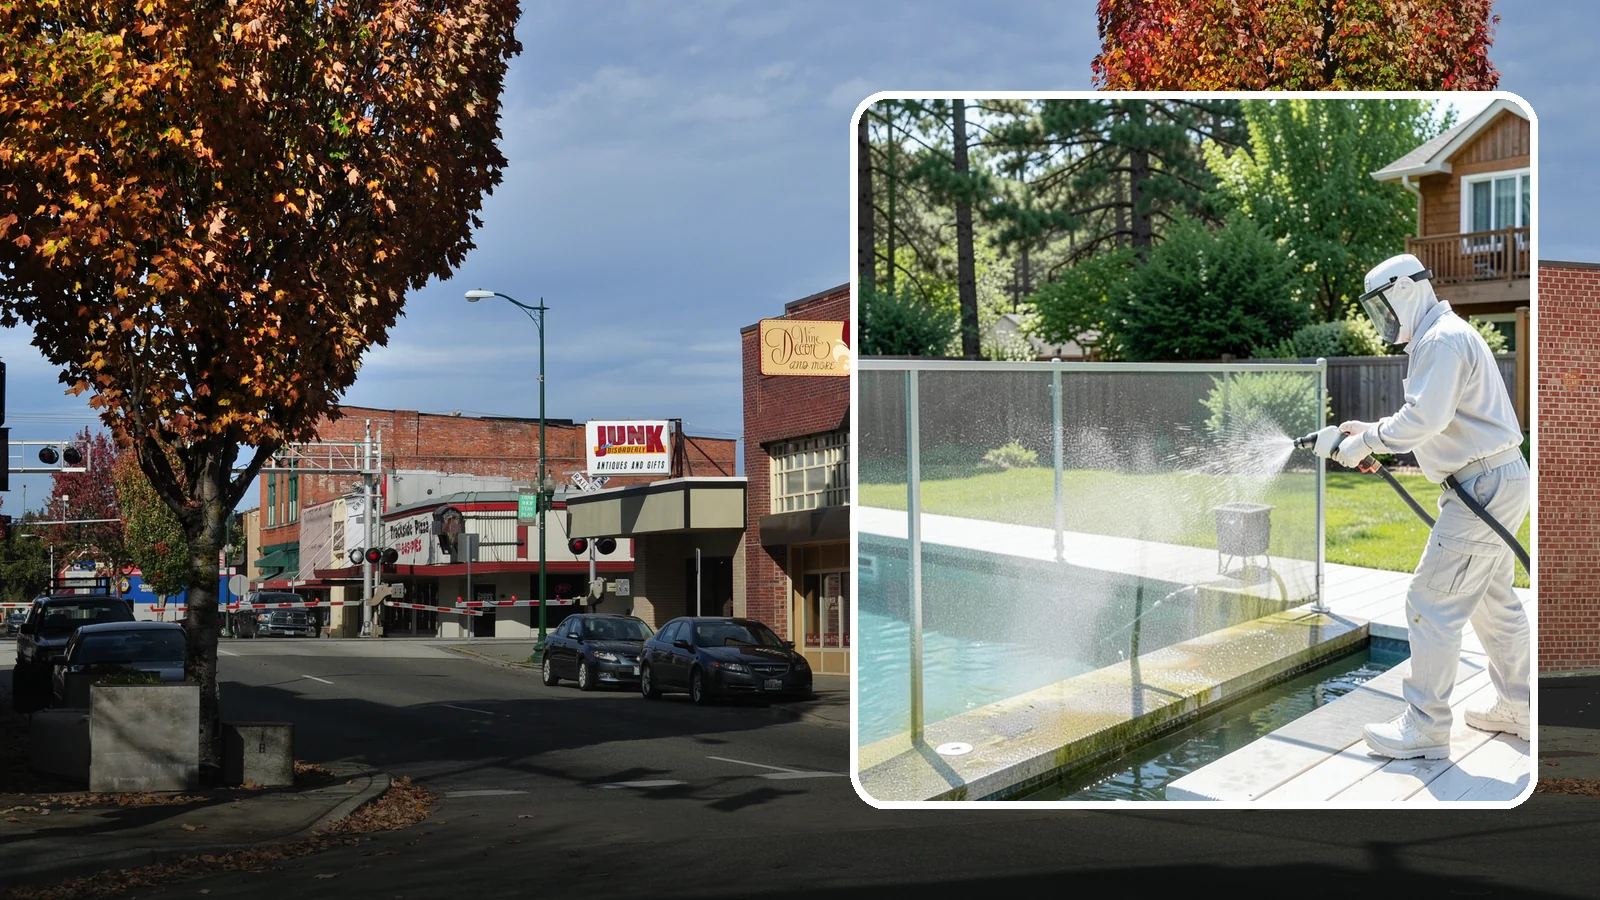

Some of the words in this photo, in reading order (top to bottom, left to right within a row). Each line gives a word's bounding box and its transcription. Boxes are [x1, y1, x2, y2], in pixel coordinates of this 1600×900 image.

[764, 327, 831, 365] Decor
[595, 425, 665, 457] JUNK
[607, 446, 646, 454] DISORDERLY
[597, 461, 628, 470] ANTIQUES
[631, 461, 644, 470] AND
[647, 460, 665, 470] GIFTS
[590, 476, 608, 491] SING
[352, 498, 365, 511] CRO
[414, 519, 429, 535] Pizza
